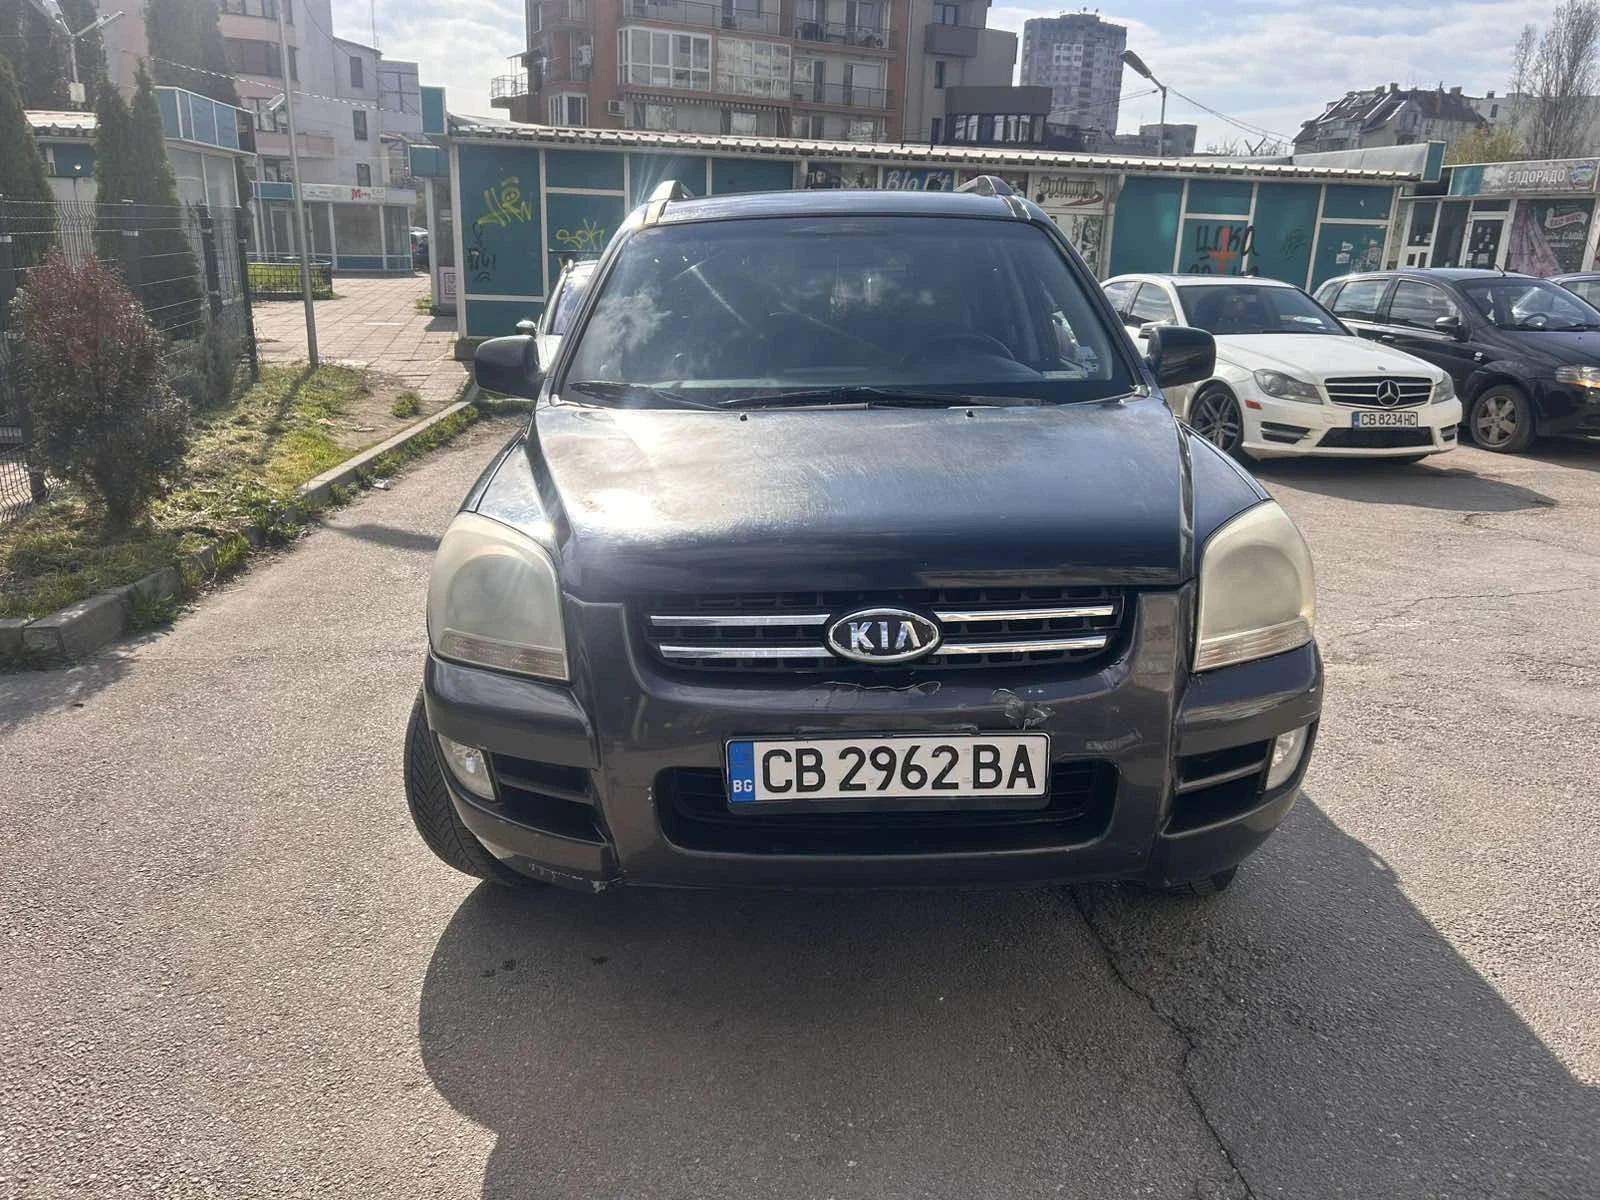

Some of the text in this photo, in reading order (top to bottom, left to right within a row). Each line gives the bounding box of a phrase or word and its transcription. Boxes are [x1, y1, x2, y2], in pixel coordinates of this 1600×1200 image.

[1507, 168, 1567, 186] ЕЛДОРАДО
[1361, 413, 1416, 426] CB 8234 HC
[848, 620, 921, 650] KIA
[762, 743, 1036, 793] CB 2962 BA
[733, 779, 752, 792] BG
